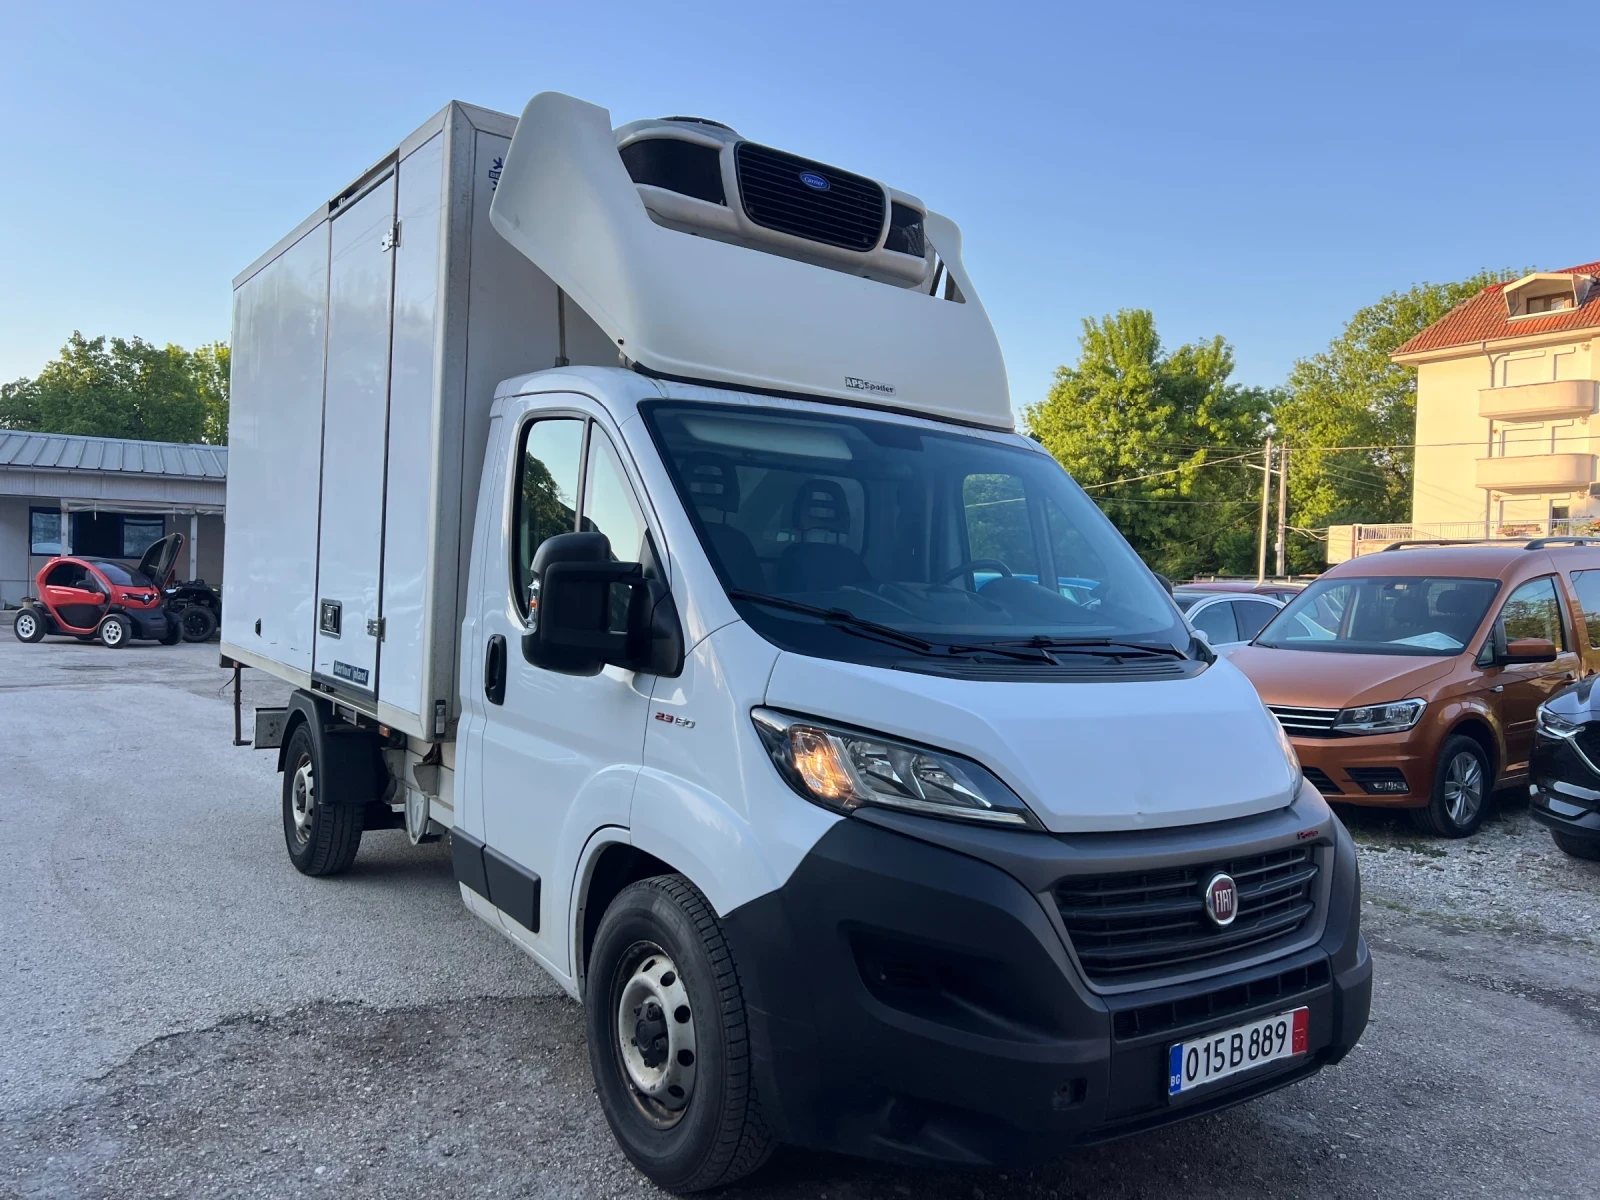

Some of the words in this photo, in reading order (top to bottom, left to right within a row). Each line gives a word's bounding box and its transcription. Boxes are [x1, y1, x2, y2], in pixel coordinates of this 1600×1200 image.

[804, 176, 824, 186] Carrier
[845, 377, 864, 389] APS
[864, 381, 893, 393] Spoiler
[1215, 888, 1232, 913] FIAT
[1186, 1020, 1287, 1082] 015B889
[1170, 1074, 1181, 1087] BG
